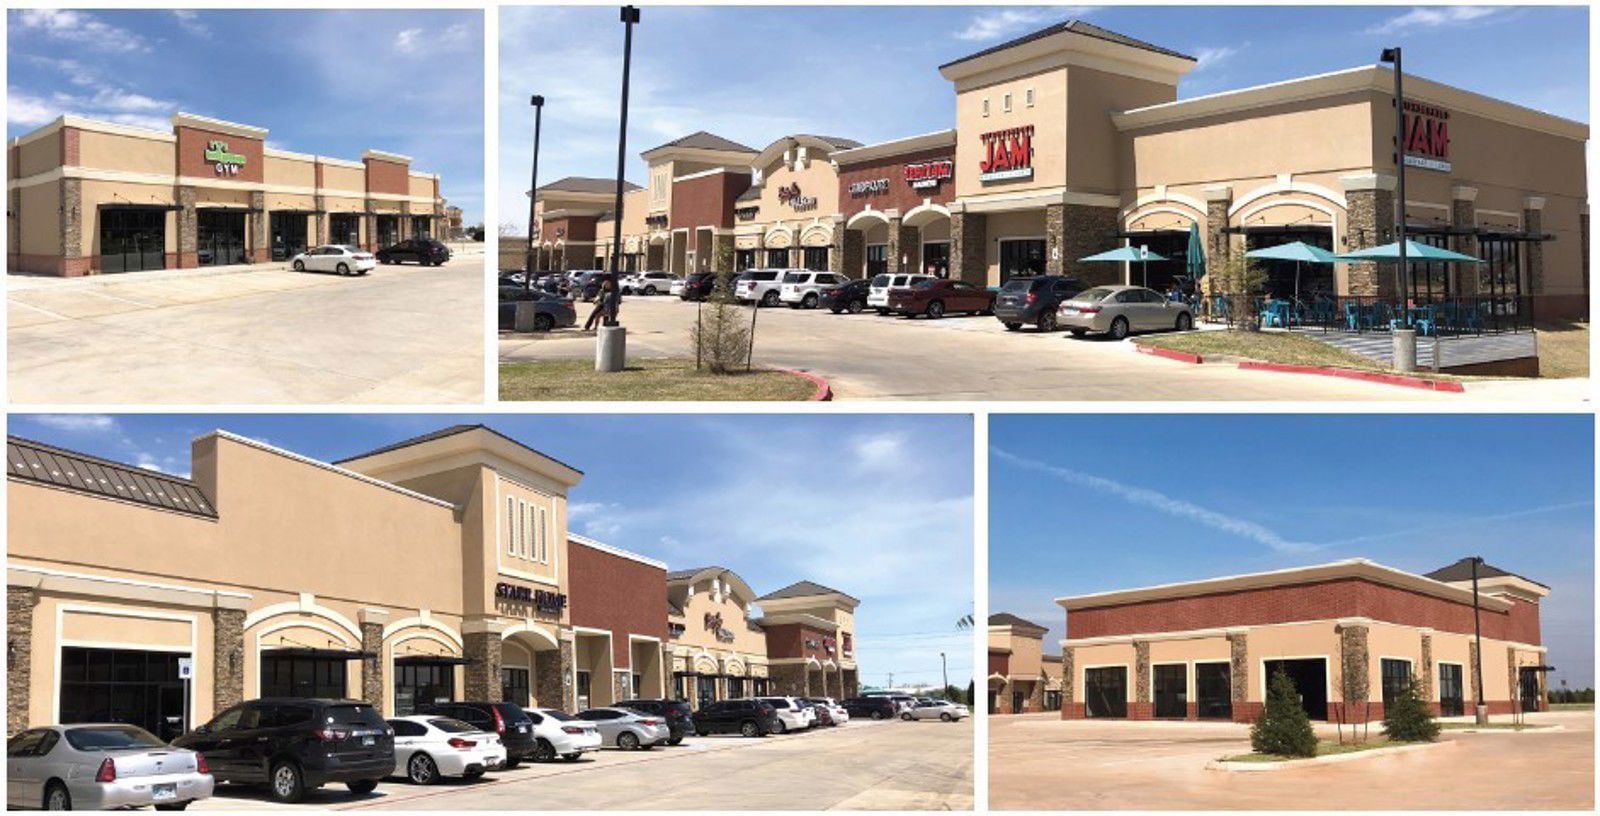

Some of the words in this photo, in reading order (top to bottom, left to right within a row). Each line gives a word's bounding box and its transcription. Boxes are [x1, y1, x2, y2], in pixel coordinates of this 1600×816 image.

[1403, 106, 1448, 157] JAM
[215, 162, 238, 174] GYM
[979, 132, 1029, 172] JAM
